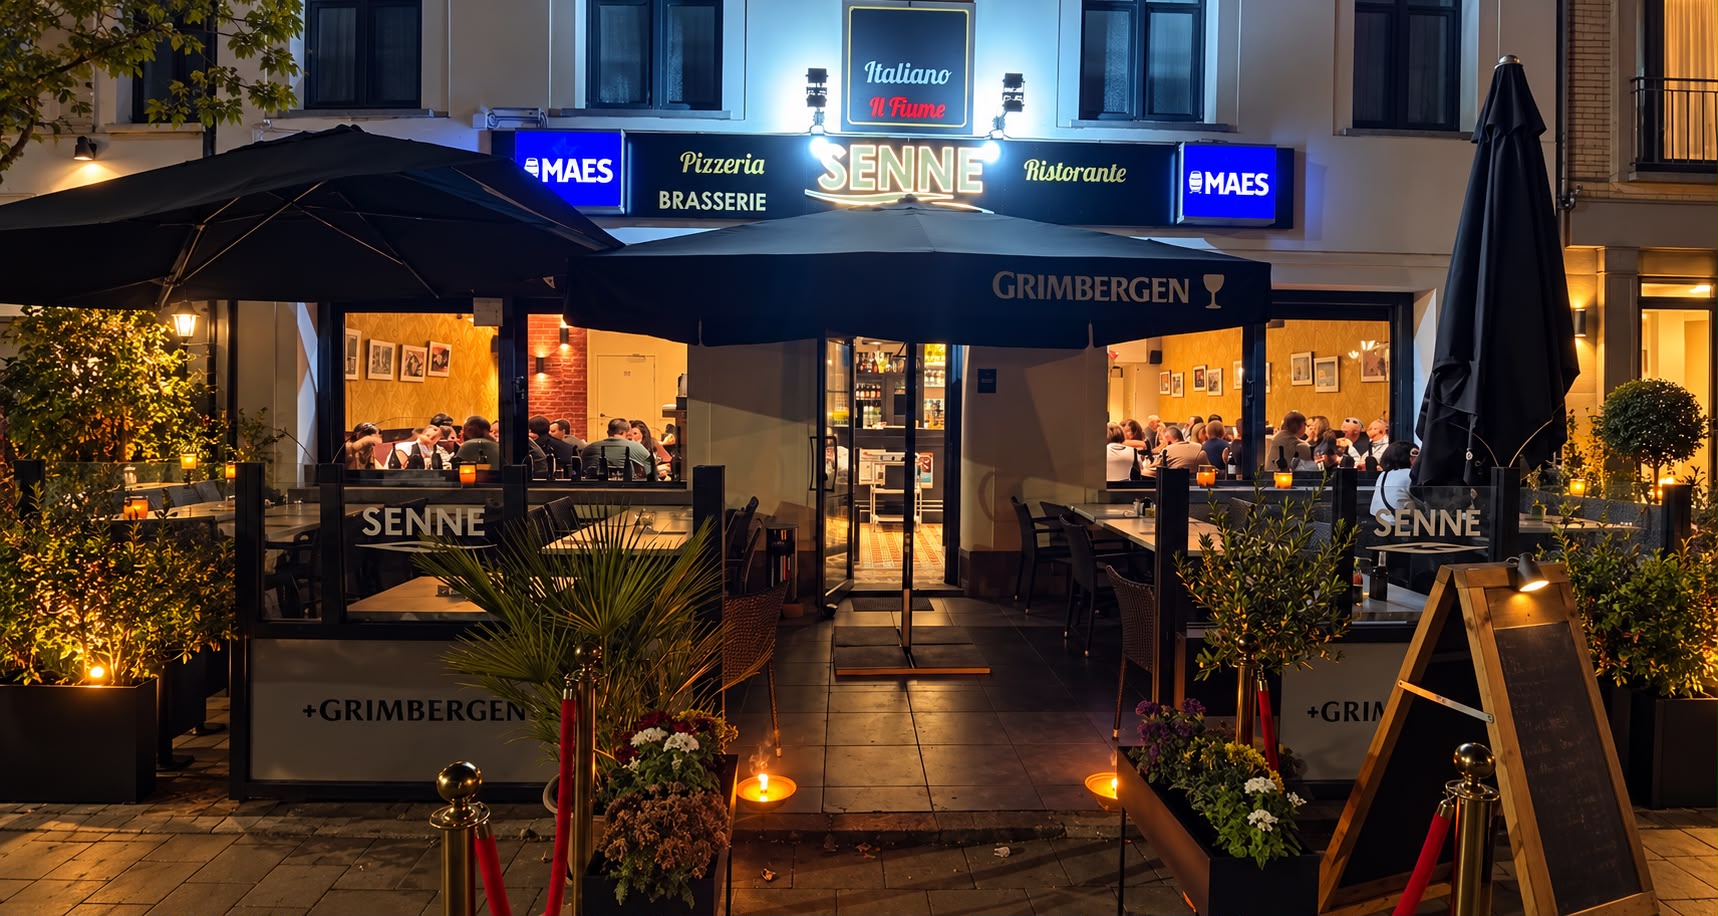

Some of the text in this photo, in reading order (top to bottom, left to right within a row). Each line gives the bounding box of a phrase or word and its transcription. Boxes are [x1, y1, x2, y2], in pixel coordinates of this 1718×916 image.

[864, 60, 952, 85] Italiano
[869, 96, 946, 119] Il Fiume
[541, 158, 613, 183] MAES
[680, 151, 765, 175] Pizzeria
[817, 143, 984, 193] SENNE
[1024, 159, 1127, 183] Ristorante
[1204, 172, 1269, 197] MAES
[659, 191, 767, 211] BRASSERIE
[992, 270, 1190, 304] GRIMBERGEN
[361, 506, 486, 537] SENNE
[1374, 509, 1481, 537] SENNE
